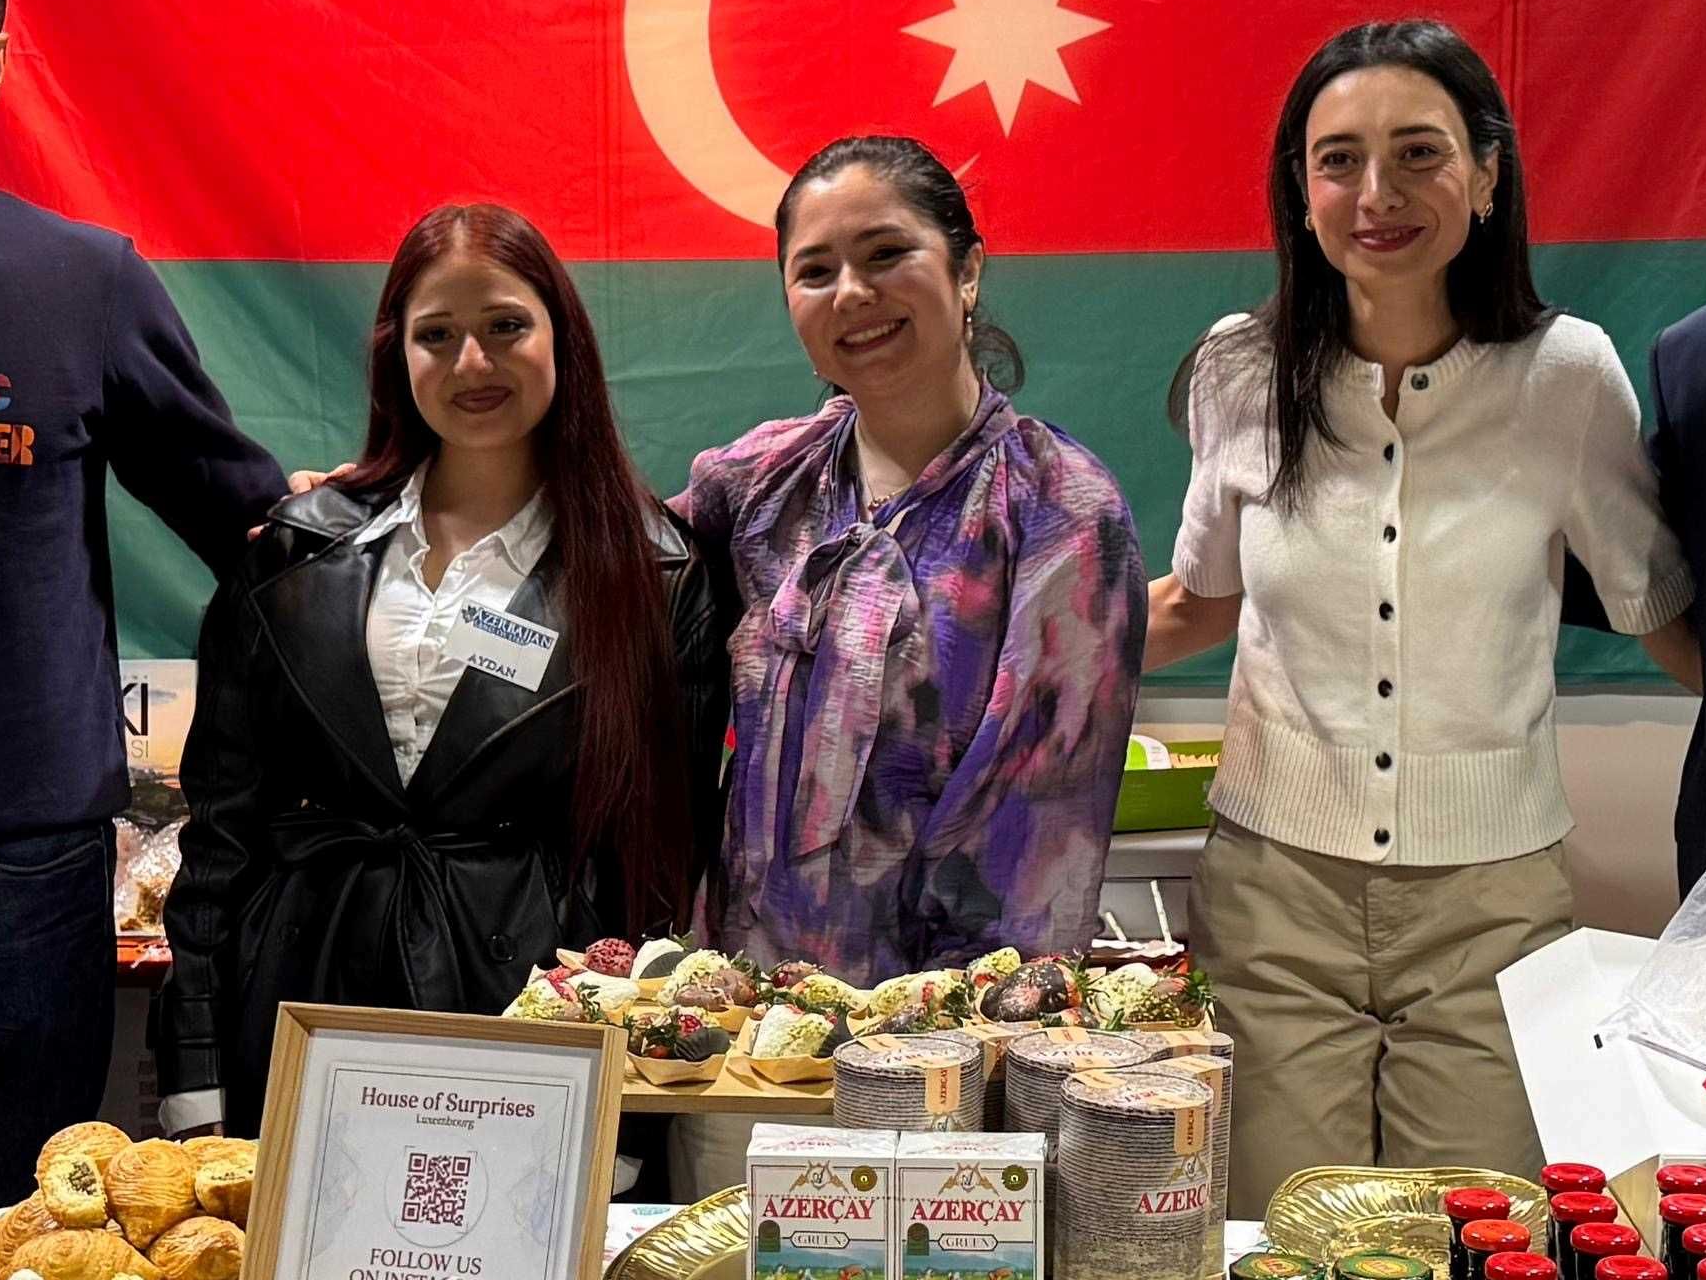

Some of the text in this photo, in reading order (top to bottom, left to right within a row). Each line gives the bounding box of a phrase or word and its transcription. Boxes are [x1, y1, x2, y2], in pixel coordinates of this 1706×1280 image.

[468, 654, 516, 678] AYDAN
[361, 1086, 535, 1119] House of Surprises
[417, 1114, 475, 1130] Luxembourg
[762, 1196, 875, 1223] AZERÇAY
[910, 1199, 1026, 1226] AZERÇAY
[370, 1248, 482, 1275] FOLLOW US
